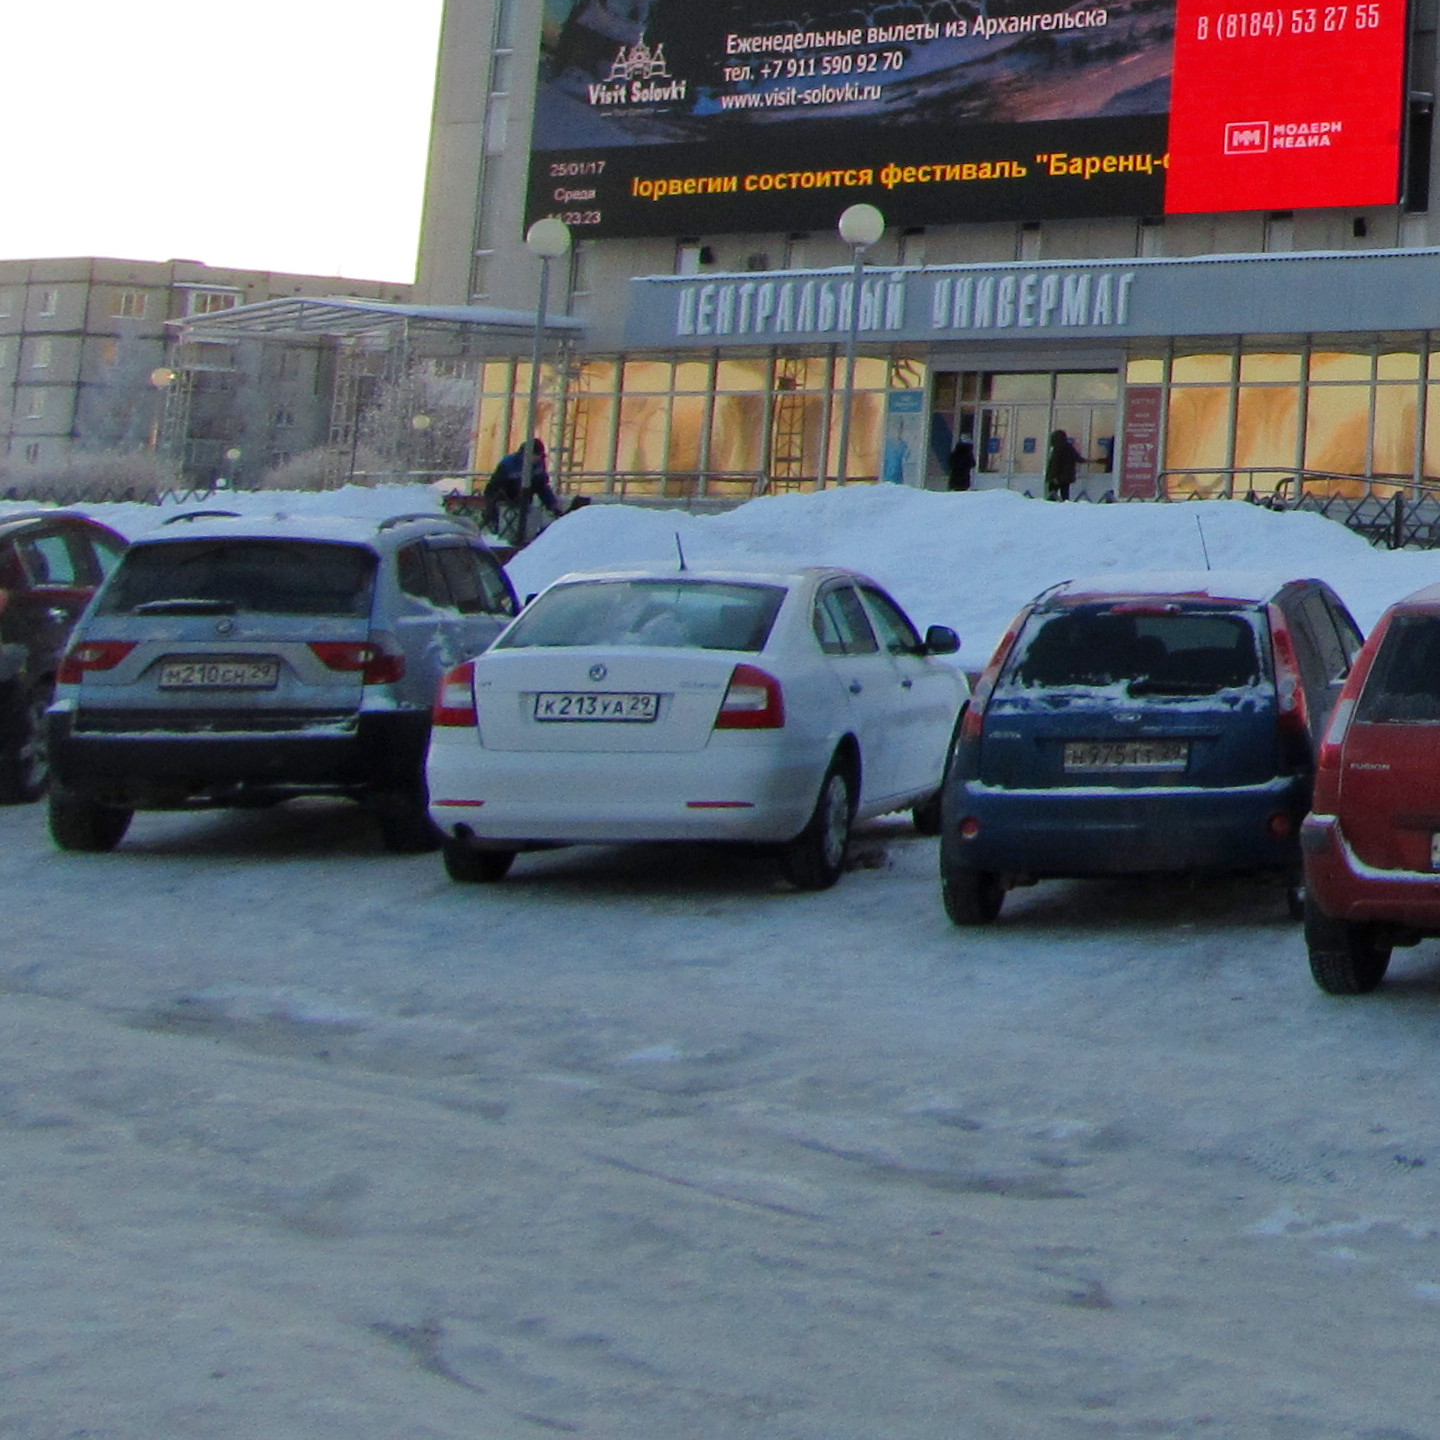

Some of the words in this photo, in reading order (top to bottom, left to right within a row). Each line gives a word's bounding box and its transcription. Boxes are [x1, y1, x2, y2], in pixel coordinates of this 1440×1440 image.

[726, 24, 861, 54] Еженедельные
[867, 24, 939, 45] вылеты
[945, 21, 967, 37] из
[972, 7, 1107, 41] Архангельска
[1197, 16, 1208, 40] 8
[1217, 10, 1283, 41] (8184)
[1291, 9, 1316, 33] 53
[1324, 6, 1348, 31] 27
[1355, 3, 1379, 29] 55
[724, 63, 754, 82] тел.
[760, 59, 781, 79] +7
[787, 56, 815, 78] 911
[822, 54, 852, 75] 590
[856, 52, 878, 73] 92
[882, 50, 903, 71] 70
[588, 82, 626, 105] Visit
[630, 79, 687, 102] Solovki
[721, 83, 882, 109] www.visit-solovki.ru
[1273, 121, 1342, 136] МОДЕРН
[1272, 135, 1331, 149] МЕДИА
[550, 161, 606, 177] 25/01/17
[744, 167, 873, 193] состоится
[881, 160, 1027, 191] фестиваль
[554, 188, 596, 203] Среда
[677, 271, 908, 335] ЦЕНТРАЛЬНЫЙ
[932, 272, 1135, 329] УНИВЕРМАГ
